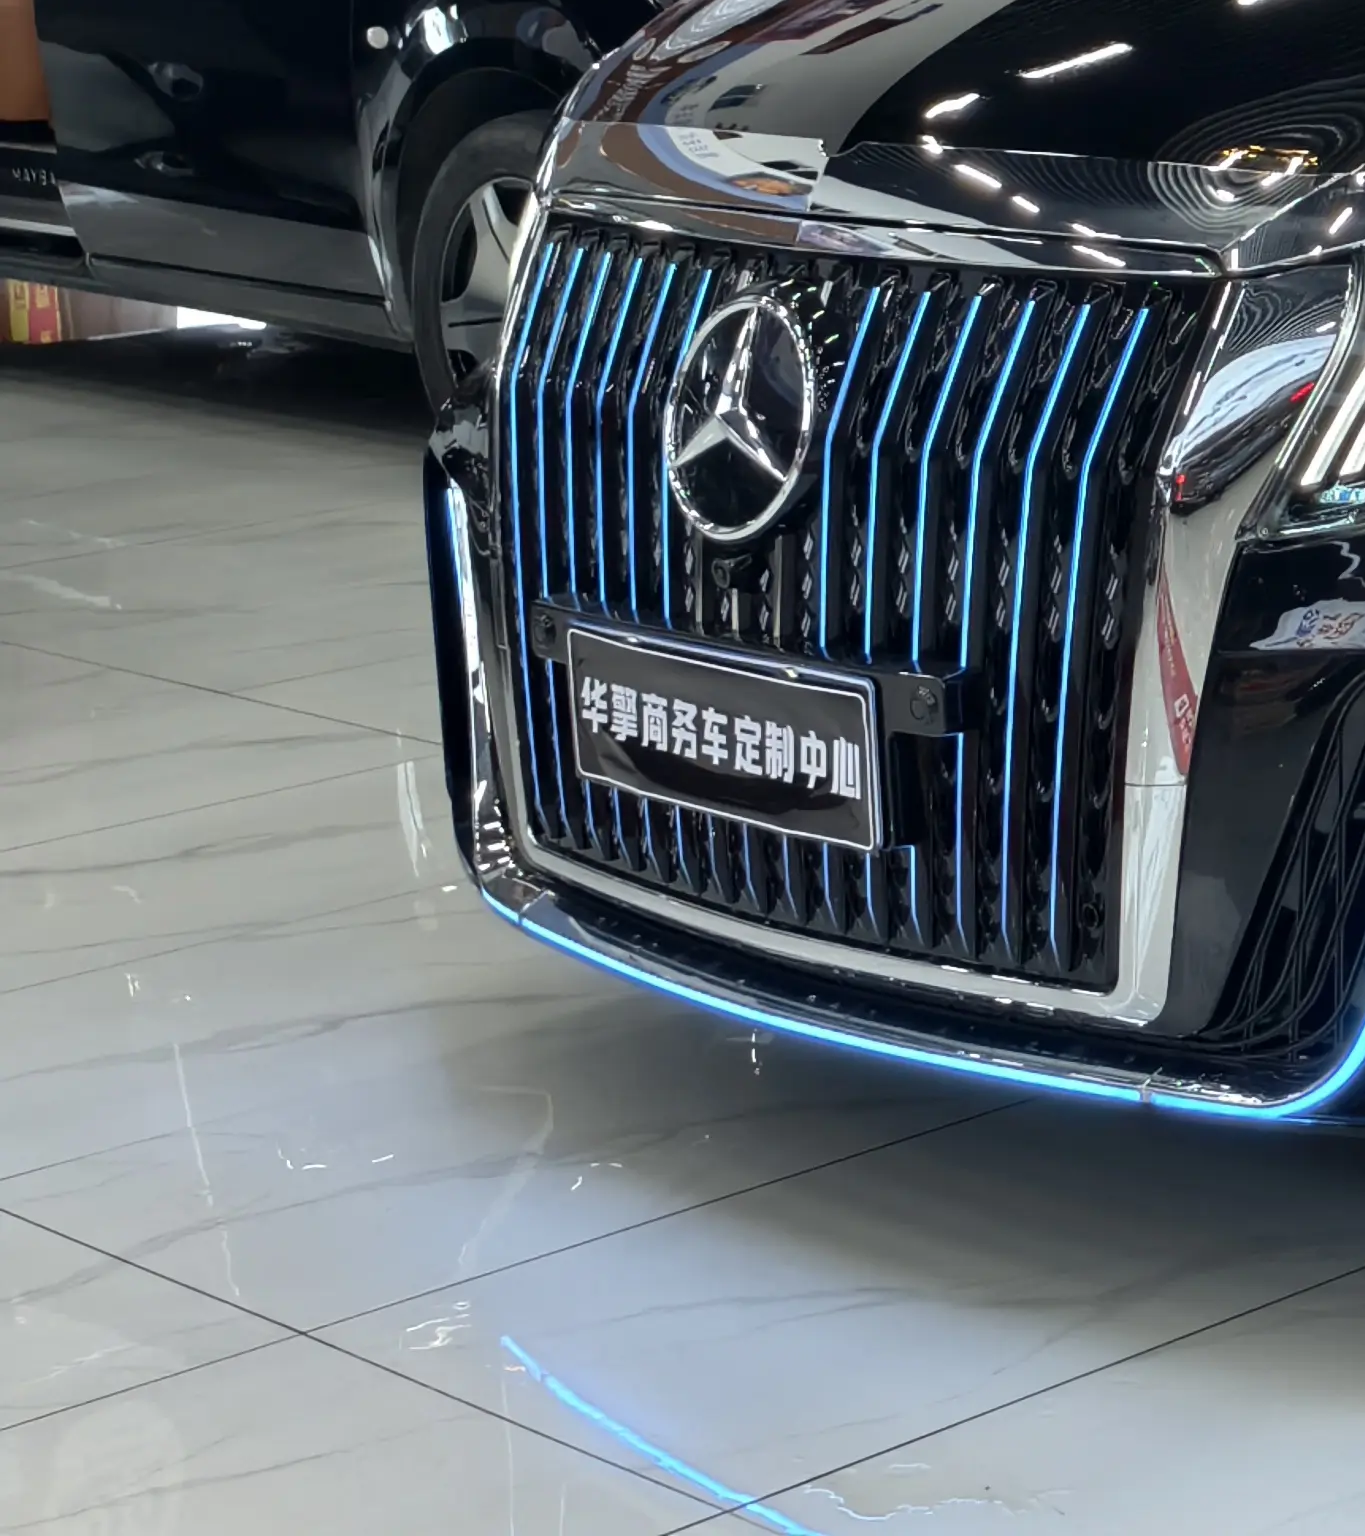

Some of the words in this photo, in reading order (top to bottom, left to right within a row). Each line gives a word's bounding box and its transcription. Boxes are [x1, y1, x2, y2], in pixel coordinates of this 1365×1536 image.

[580, 676, 862, 800] 华擎商务车定制中心
